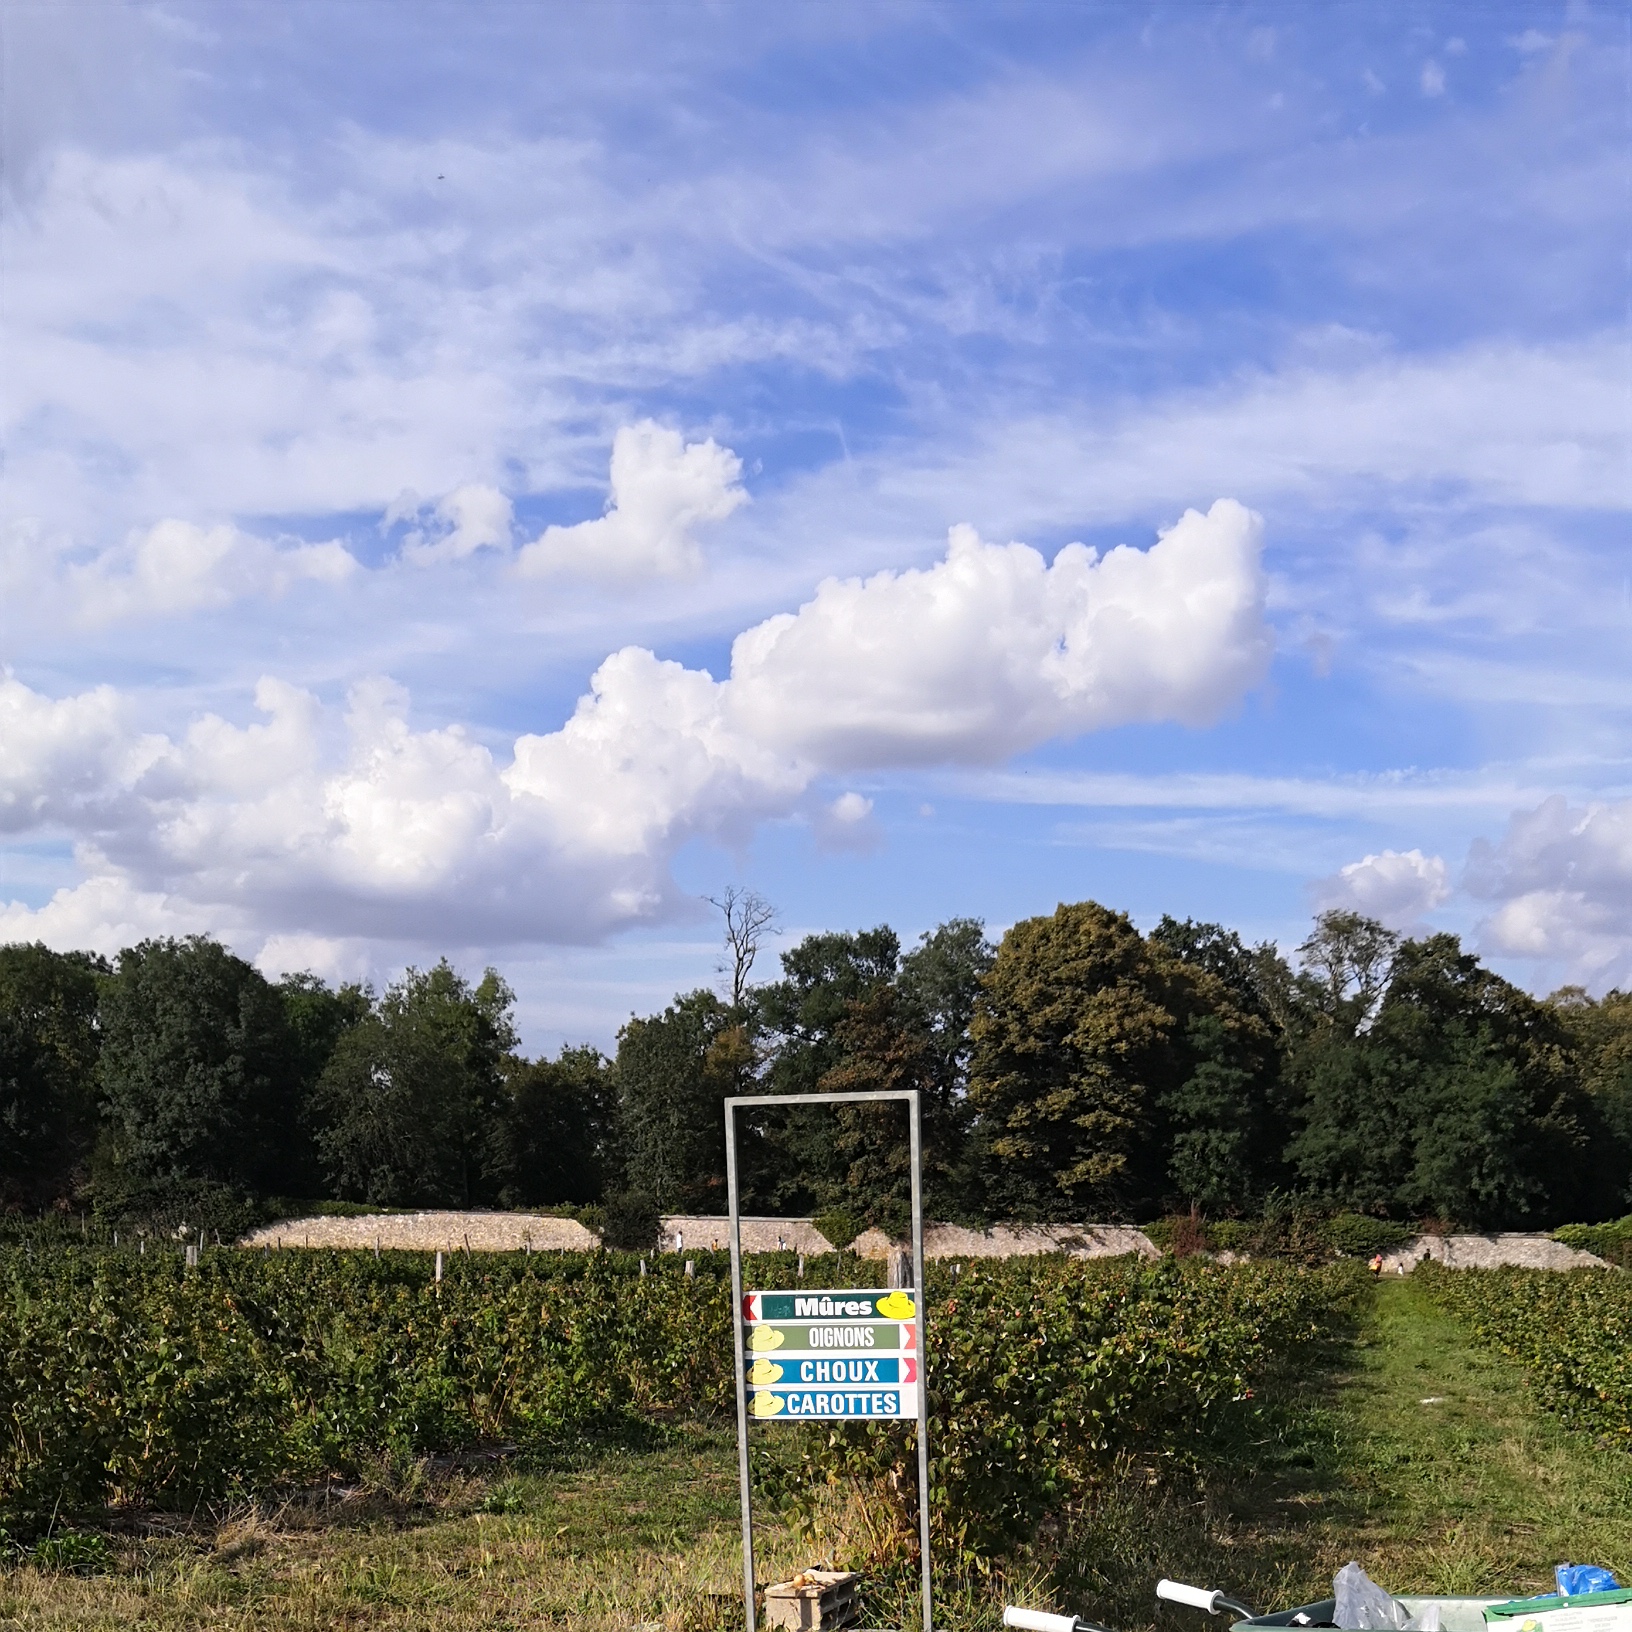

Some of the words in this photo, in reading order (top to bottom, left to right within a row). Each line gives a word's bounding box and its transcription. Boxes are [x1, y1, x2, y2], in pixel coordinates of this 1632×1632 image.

[794, 1297, 872, 1316] Mûres
[809, 1327, 874, 1347] OIGNONS
[800, 1361, 879, 1382] CHOUX
[787, 1393, 897, 1414] CAROTTES
